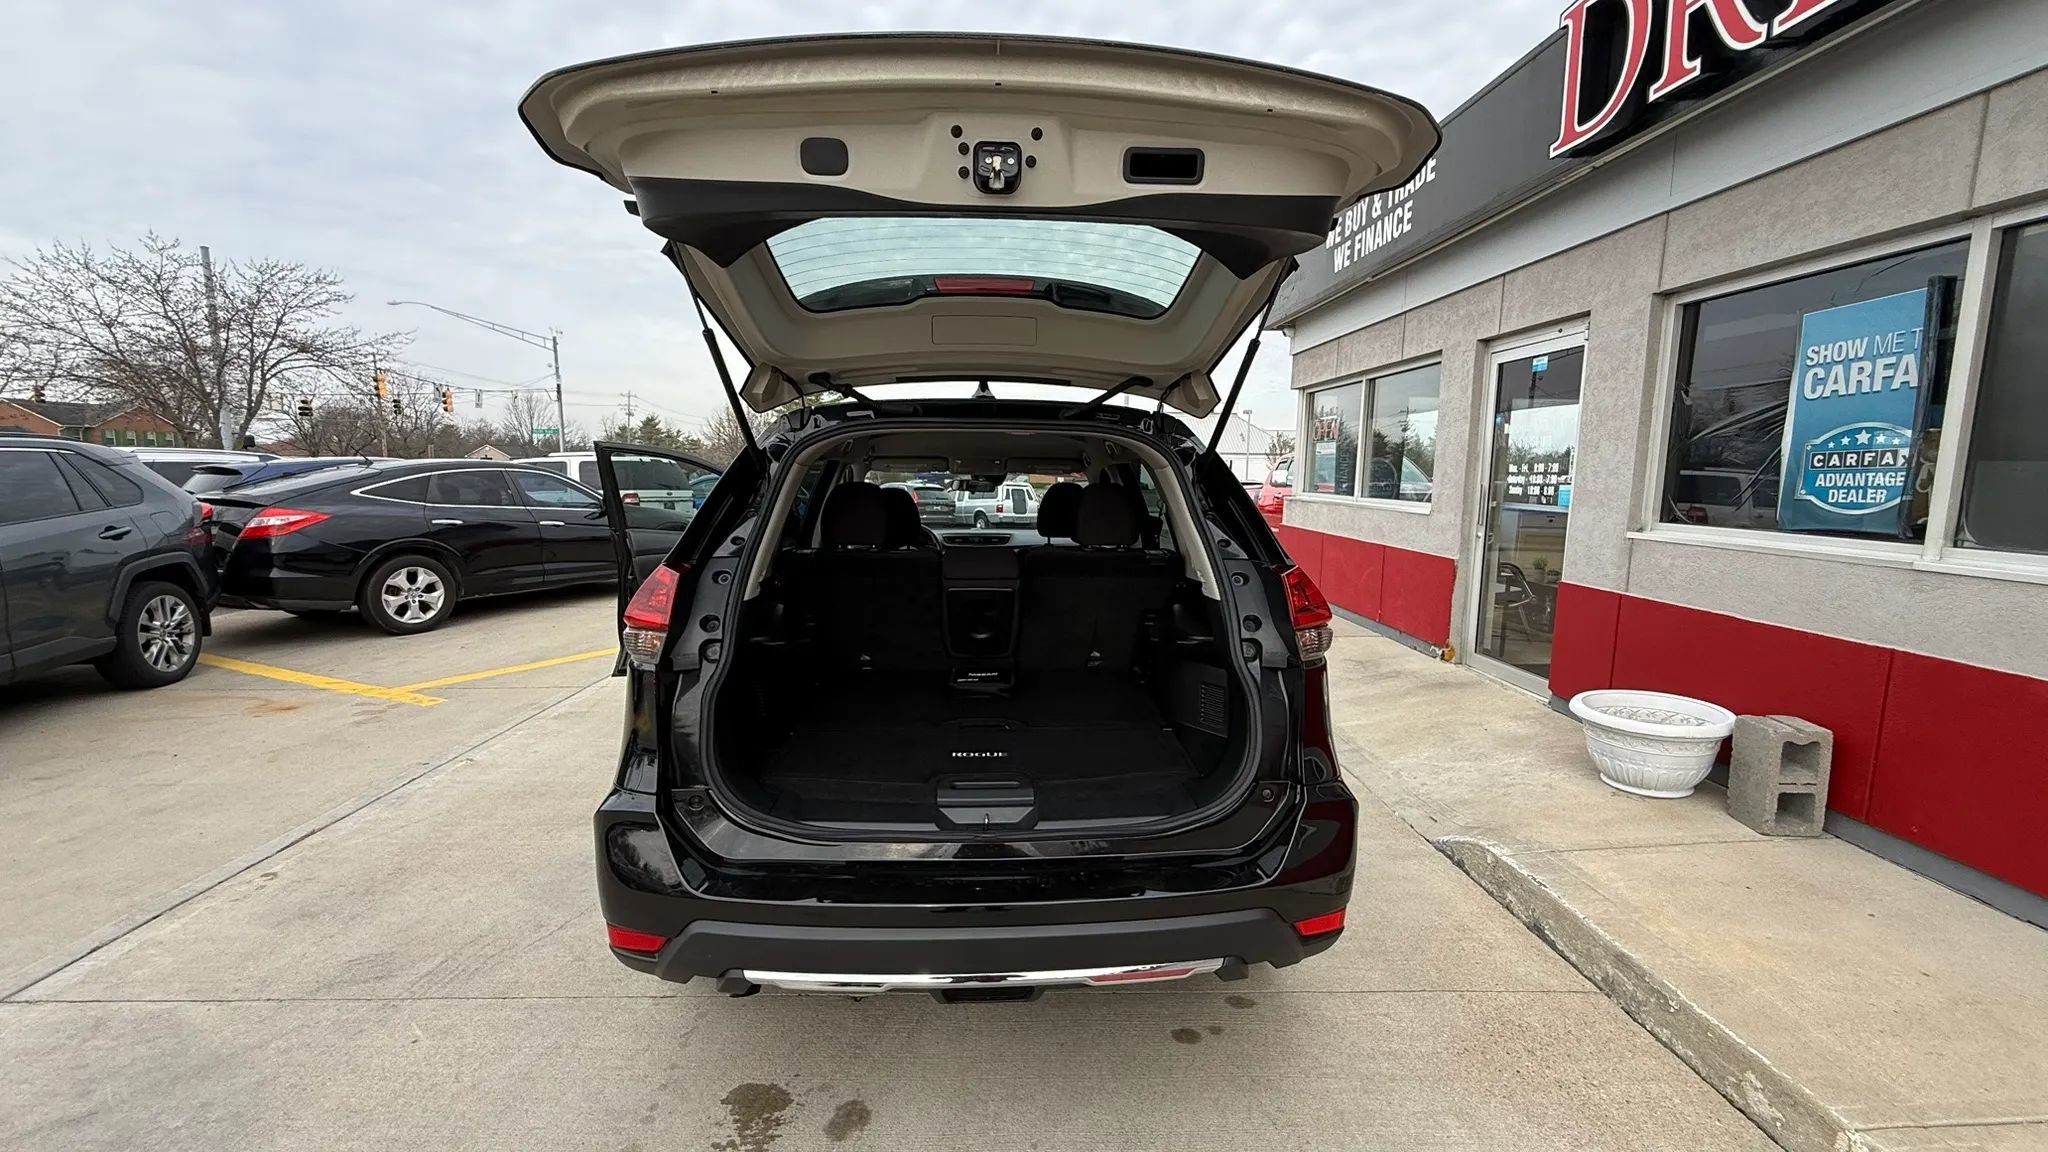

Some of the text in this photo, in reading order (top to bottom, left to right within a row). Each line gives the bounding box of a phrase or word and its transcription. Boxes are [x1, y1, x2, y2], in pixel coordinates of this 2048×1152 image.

[1550, 0, 1837, 158] DR
[1344, 197, 1369, 237] BUY
[1371, 193, 1382, 219] &
[1334, 200, 1413, 273] WE FINANCE
[1805, 337, 1868, 366] SHOW
[1873, 330, 1906, 356] ME
[1815, 472, 1906, 487] ADVANTAGE
[1828, 489, 1888, 503] DEALER
